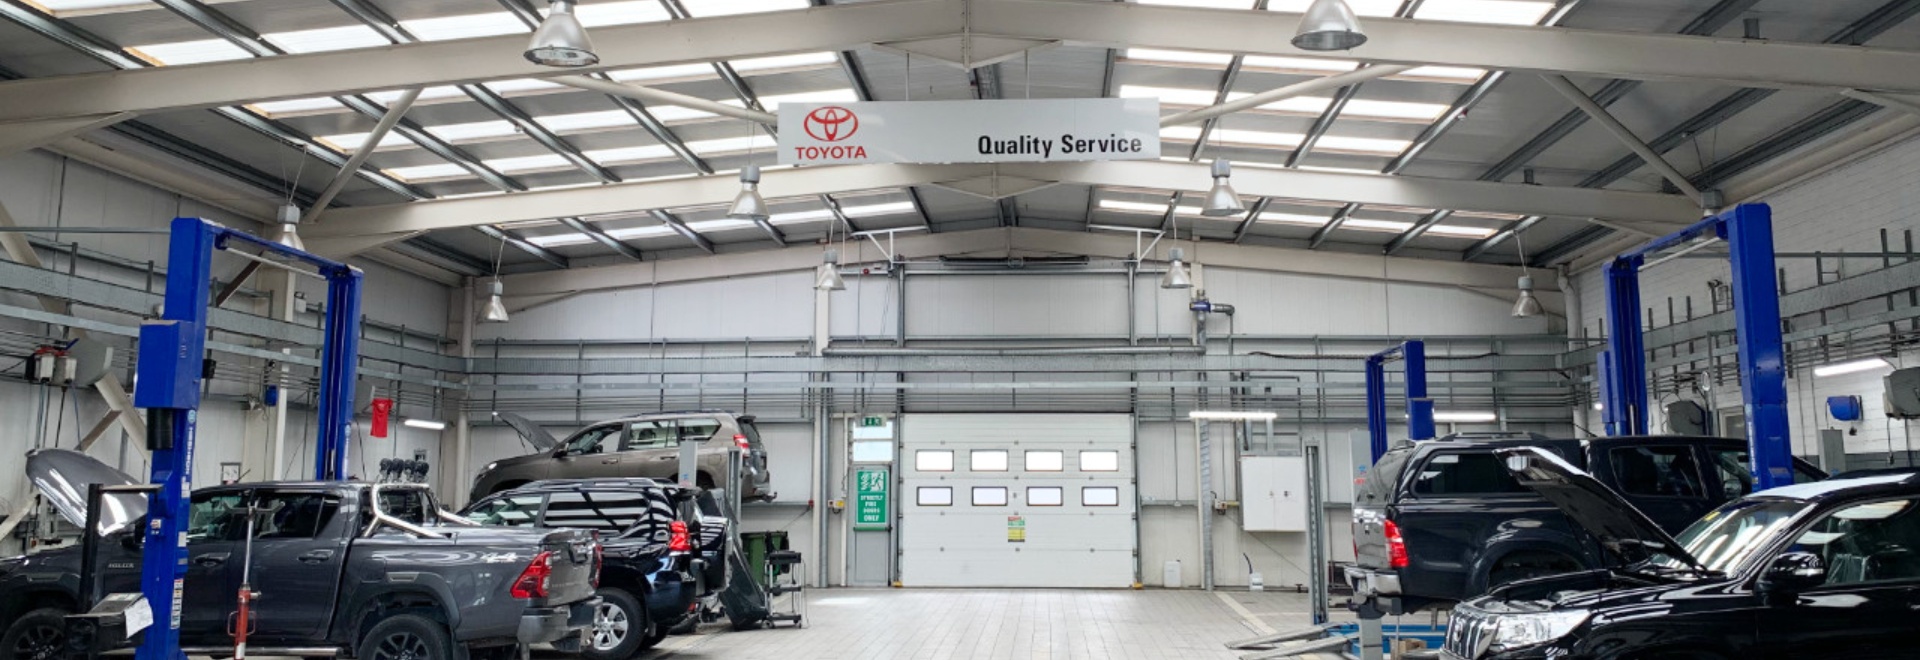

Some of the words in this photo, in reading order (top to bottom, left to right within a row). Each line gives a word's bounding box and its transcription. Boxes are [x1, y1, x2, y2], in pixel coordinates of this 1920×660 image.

[795, 146, 867, 160] TOYOTA
[978, 135, 1053, 159] Quality
[1061, 133, 1142, 154] Service
